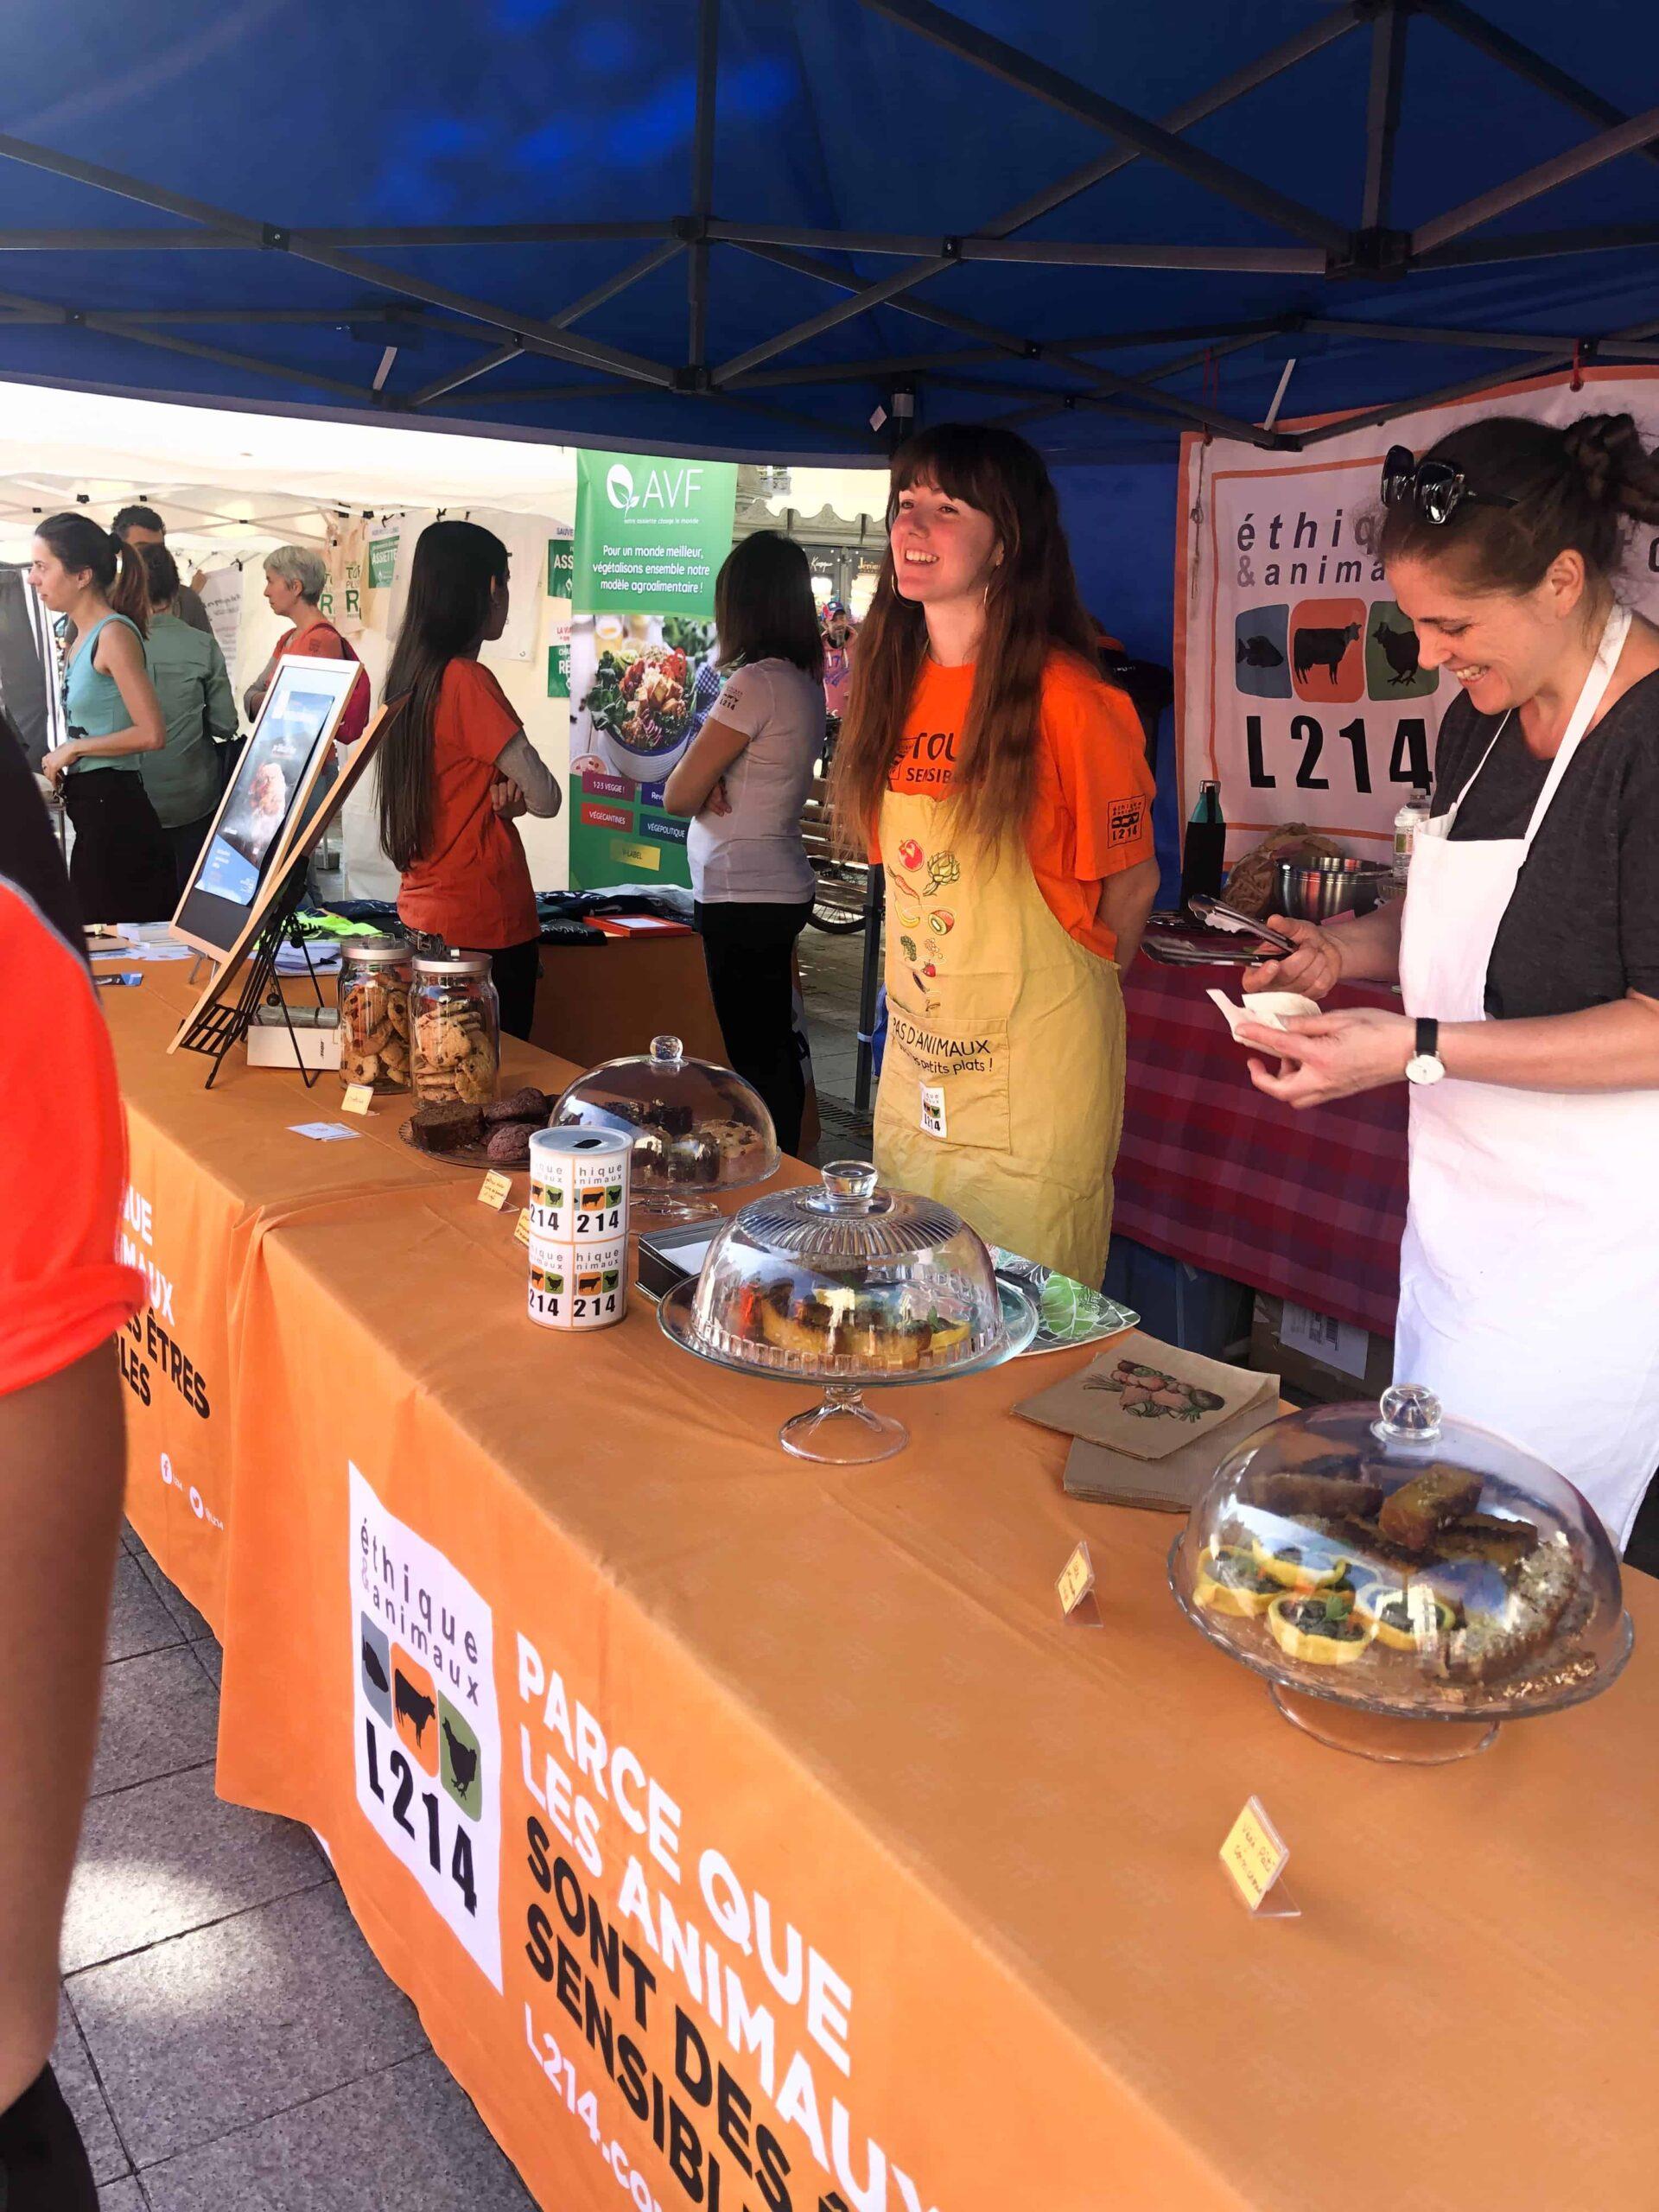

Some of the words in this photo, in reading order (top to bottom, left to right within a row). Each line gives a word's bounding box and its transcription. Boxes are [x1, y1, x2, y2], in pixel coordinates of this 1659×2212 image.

[643, 468, 703, 509] AVF
[603, 544, 621, 556] Pour
[623, 547, 632, 556] un
[635, 544, 664, 557] monde
[666, 545, 703, 560] meilleur,
[1236, 509, 1376, 556] éthiq
[593, 561, 644, 575] végétalisons
[645, 563, 685, 575] ensemble
[688, 565, 710, 576] notre
[601, 579, 629, 591] modèle
[632, 580, 699, 594] agroalimentaire
[1246, 715, 1433, 796] L214
[605, 783, 623, 793] VEGGIE
[589, 810, 626, 825] VÉGÉCANTINES
[647, 822, 685, 838] VÉGÉPOLITIQUE
[906, 1027, 991, 1058] D'ANIMAUX
[953, 1057, 985, 1075] plats
[576, 1210, 620, 1233] 214
[573, 1294, 616, 1318] 214
[120, 1336, 151, 1407] LES
[147, 1306, 210, 1420] ÊTRES
[360, 1517, 478, 1664] éthique
[365, 1716, 476, 1918] L214
[516, 1630, 681, 1885] PARCE
[698, 1848, 852, 2078] QUE
[520, 1722, 603, 1878] LES
[617, 1854, 943, 2212] ANIMAU
[525, 1815, 656, 2032] SONT
[675, 2004, 792, 2212] DES
[524, 1903, 750, 2212] SENSIB
[524, 2001, 663, 2212] L214.CO
